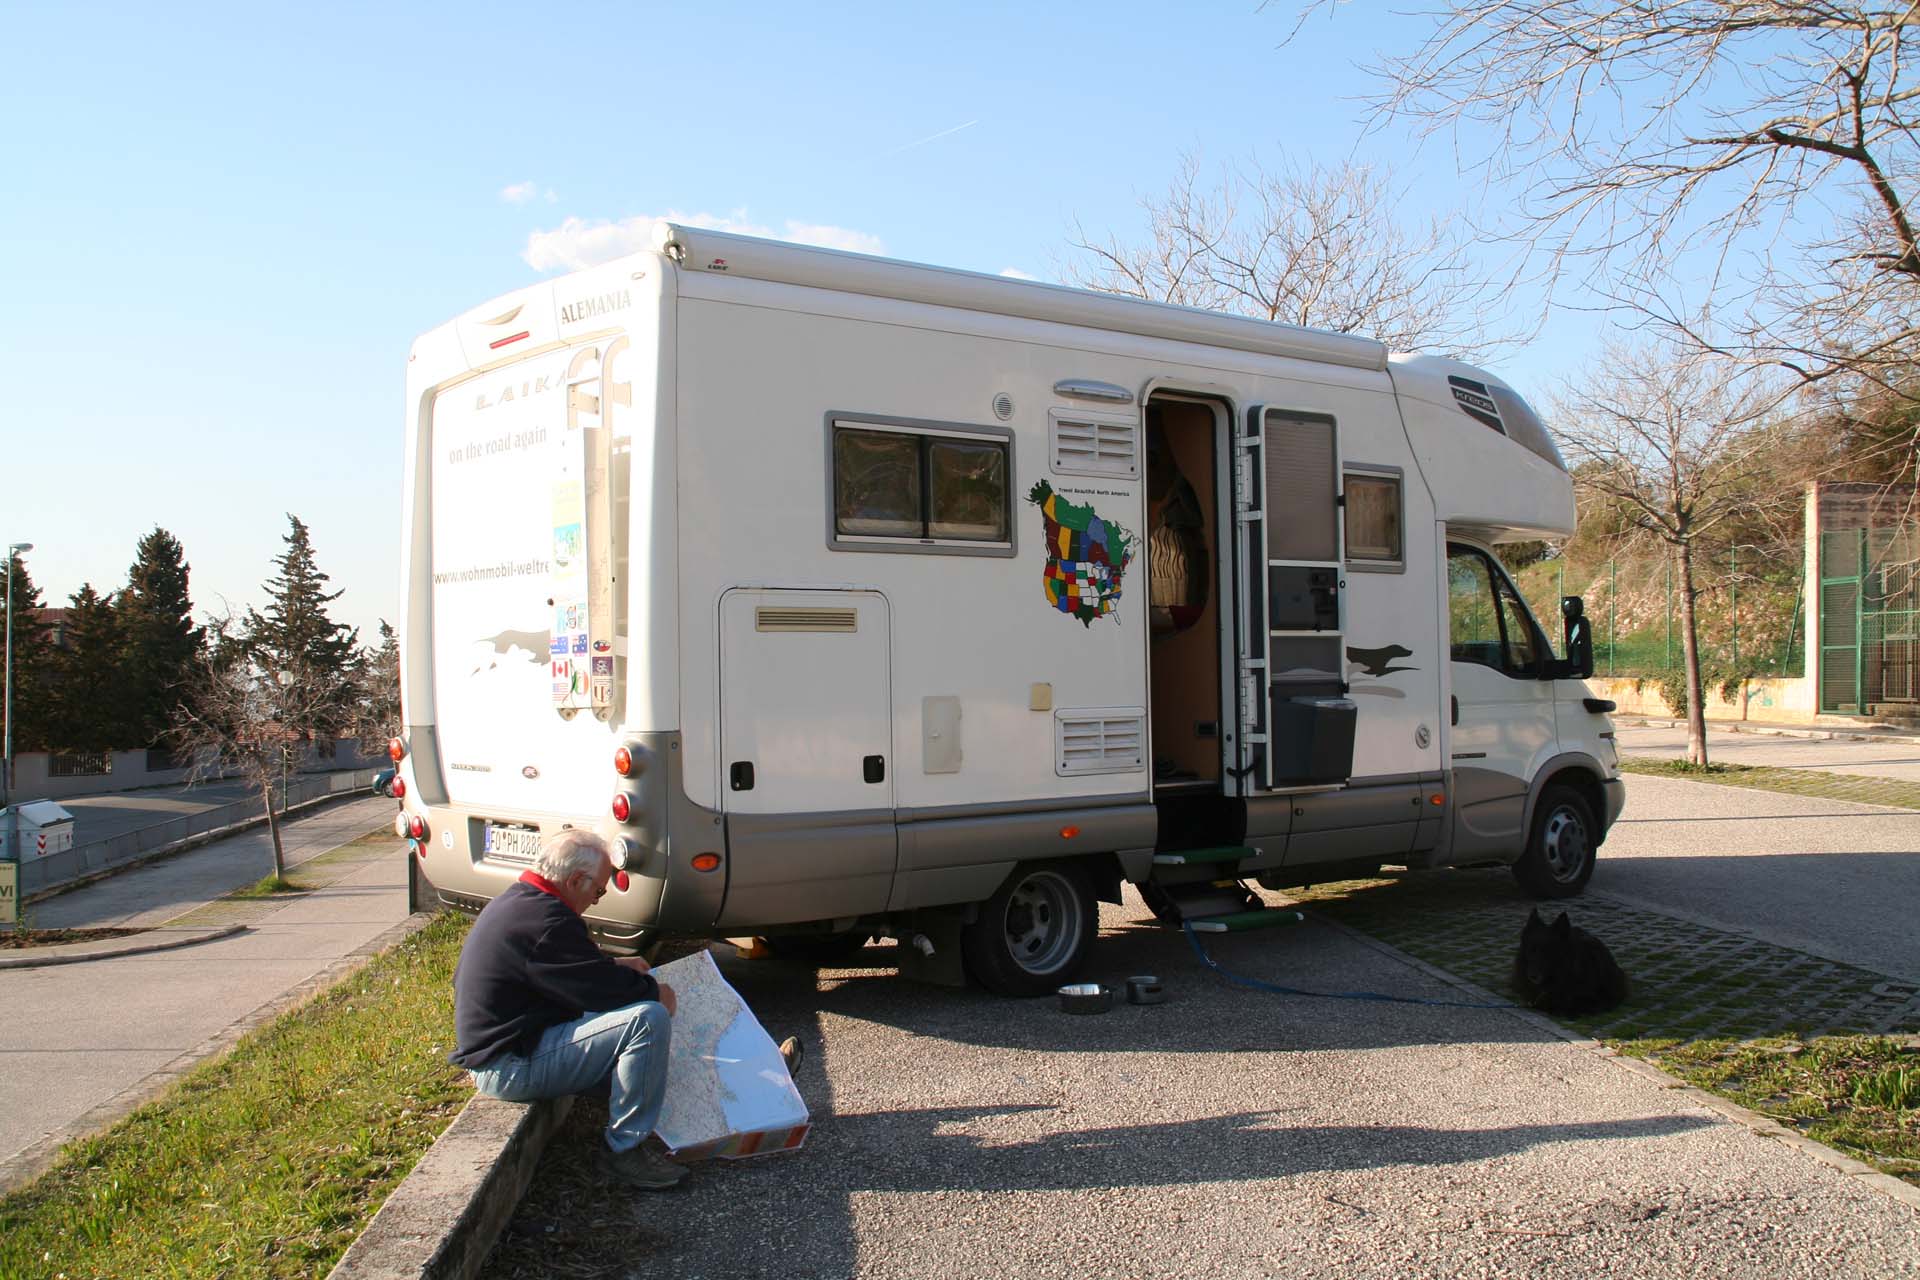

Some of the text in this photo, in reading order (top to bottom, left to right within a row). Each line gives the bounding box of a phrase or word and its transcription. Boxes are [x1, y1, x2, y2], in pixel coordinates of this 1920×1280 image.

[560, 288, 632, 325] ALEMANIA
[449, 426, 548, 465] on the road again
[507, 832, 519, 853] PH
